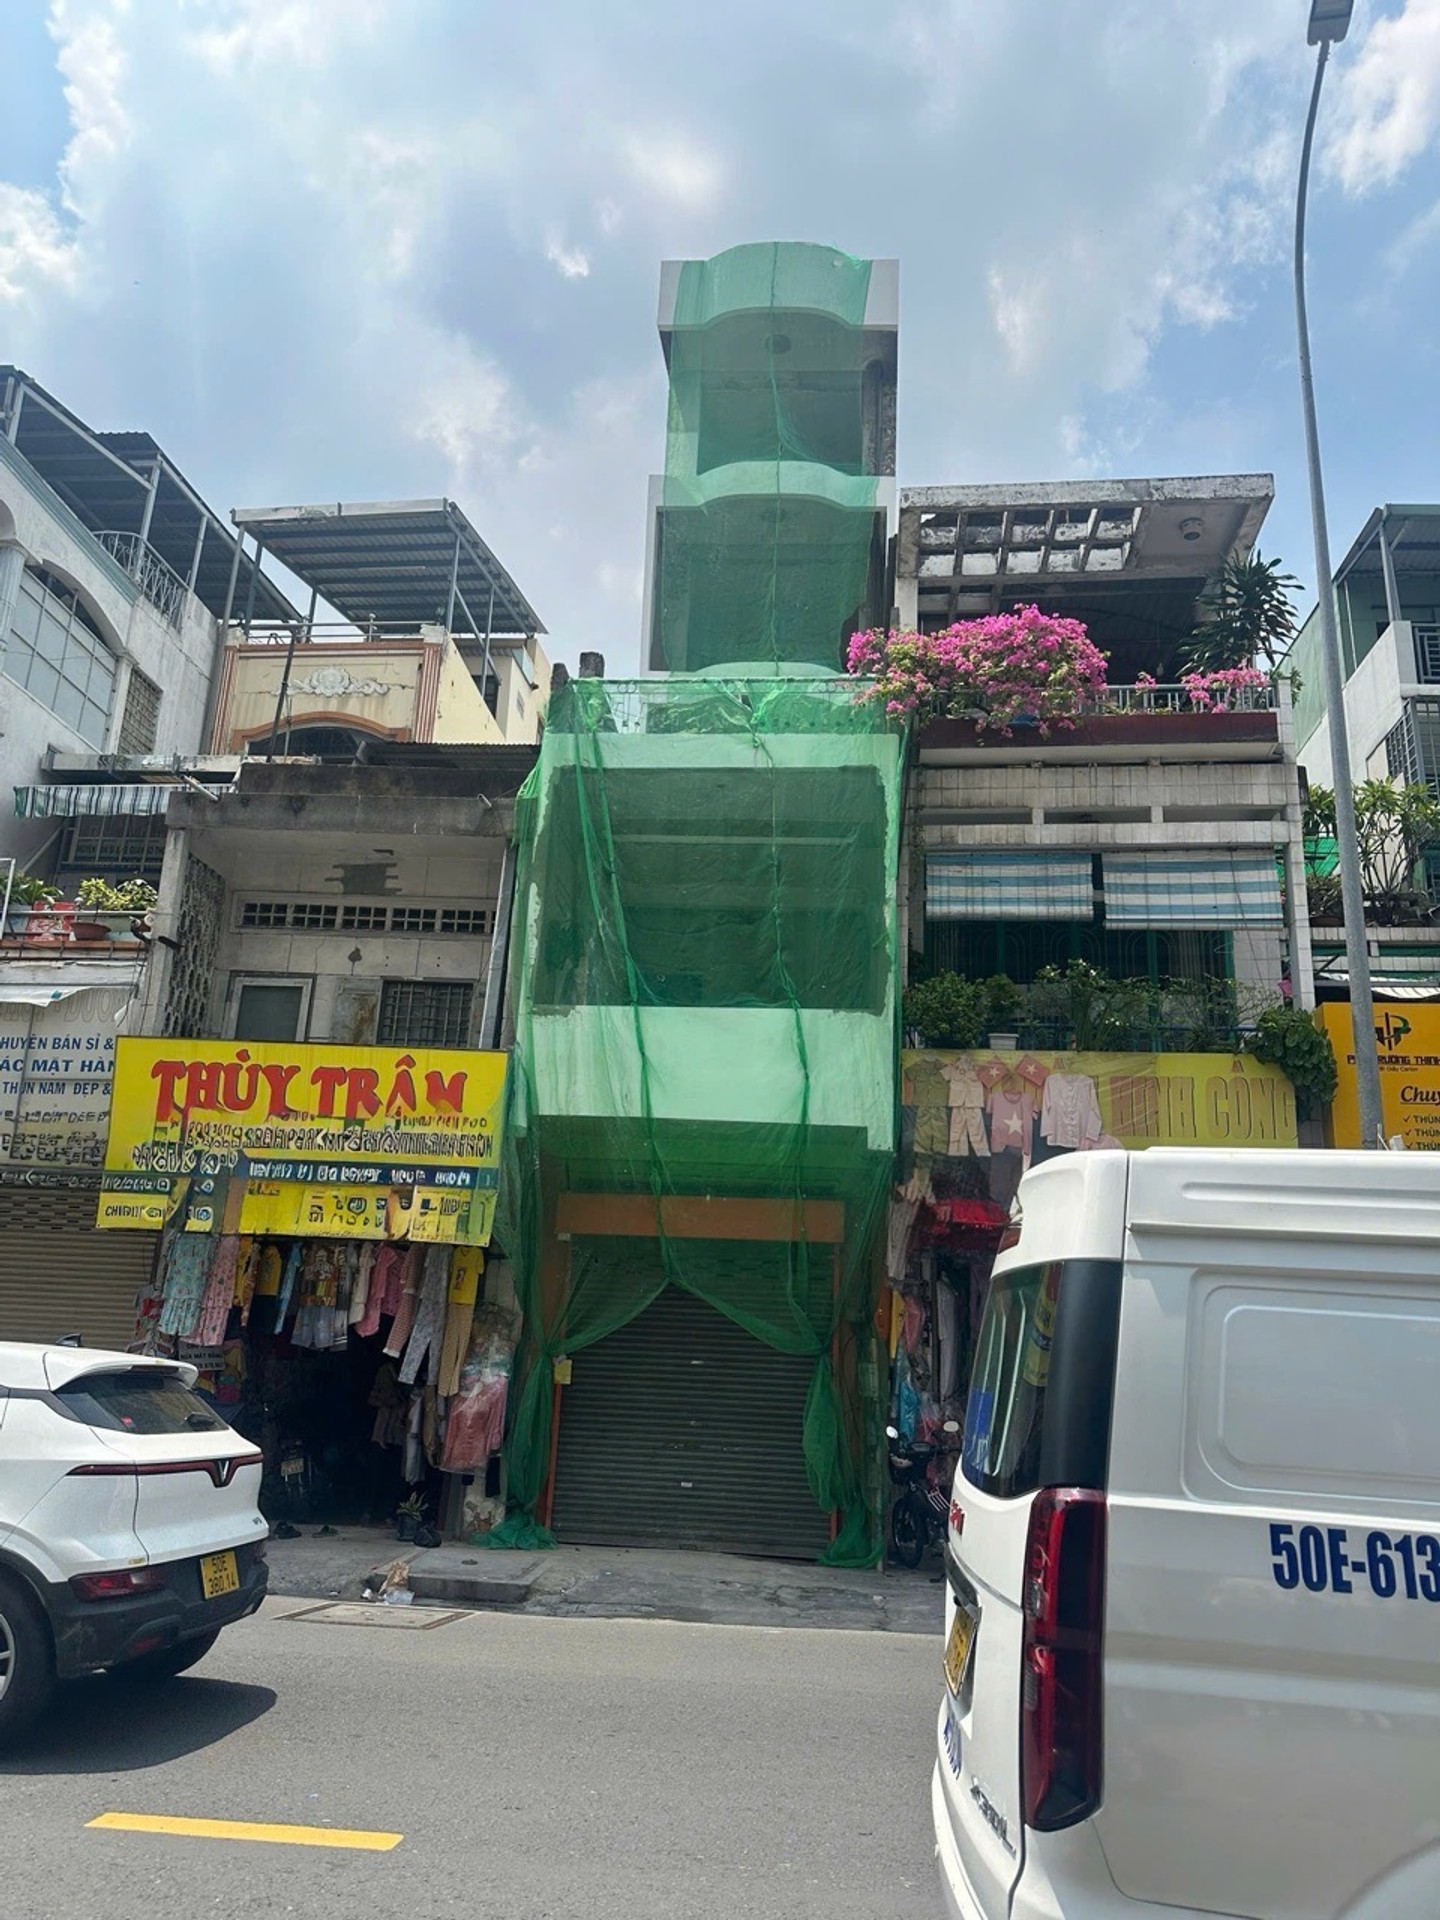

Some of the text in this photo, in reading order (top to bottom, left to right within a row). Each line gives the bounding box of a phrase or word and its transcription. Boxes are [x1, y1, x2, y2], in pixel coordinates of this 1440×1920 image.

[52, 1033, 82, 1050] BÁN
[103, 1037, 114, 1050] &
[31, 1057, 74, 1076] MẶT
[38, 1081, 66, 1095] NAM
[1269, 1523, 1440, 1603] 50E-613
